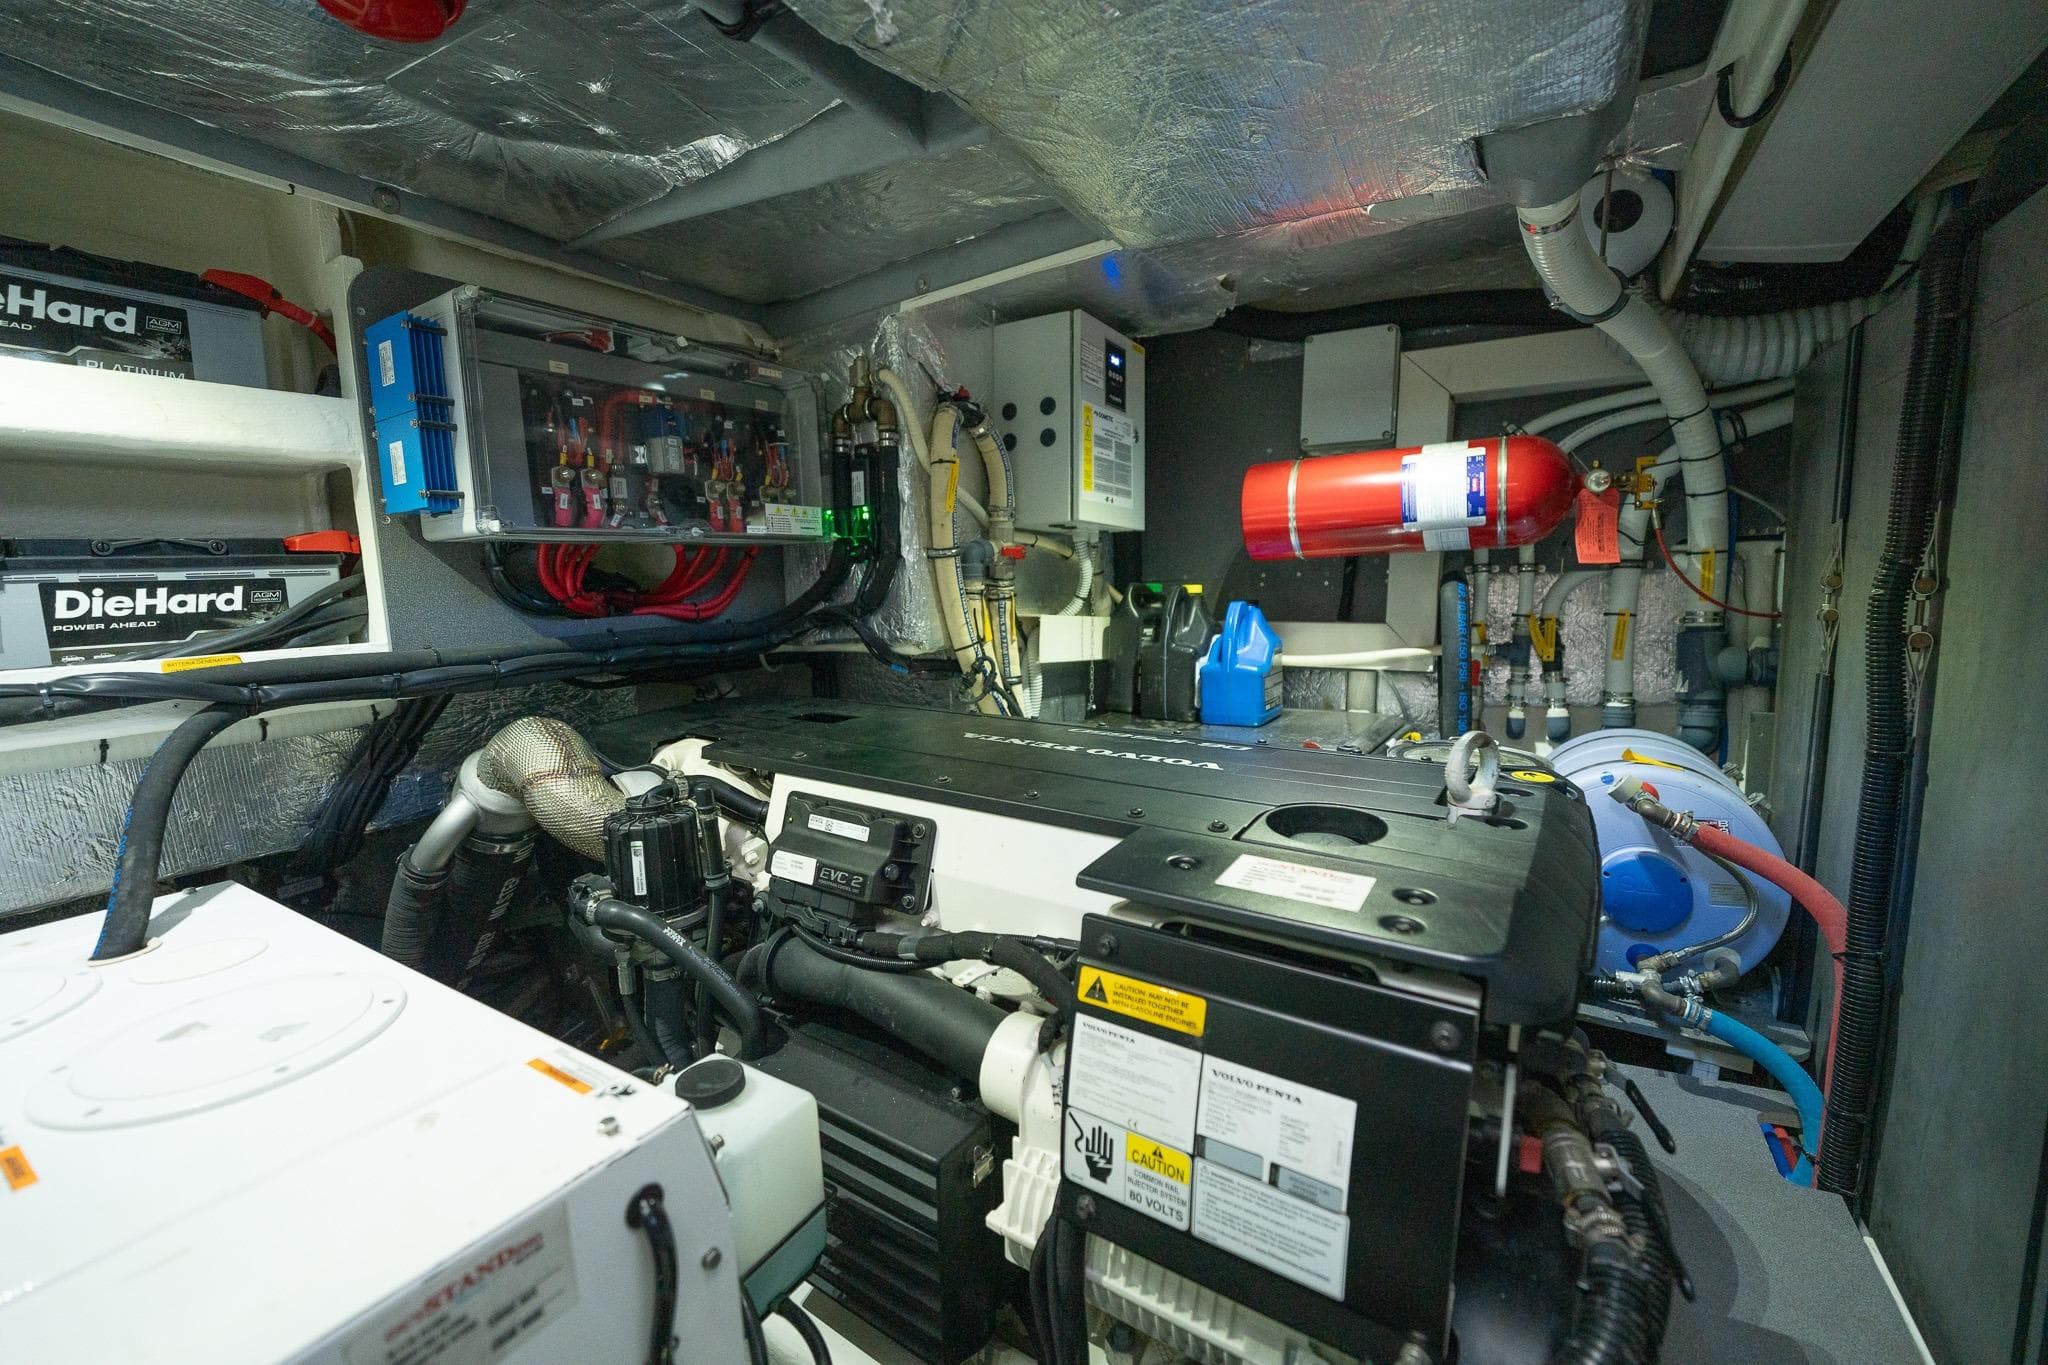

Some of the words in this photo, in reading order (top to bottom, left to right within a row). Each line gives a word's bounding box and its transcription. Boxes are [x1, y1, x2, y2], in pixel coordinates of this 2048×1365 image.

[54, 586, 243, 619] DieHard
[1458, 600, 1467, 610] 10
[52, 623, 105, 632] POWER
[109, 621, 156, 629] AHEAD
[1458, 613, 1468, 634] BAR
[1458, 692, 1468, 710] ISO
[963, 732, 1085, 751] PENTA
[1086, 748, 1224, 770] VOLVO
[820, 867, 848, 884] EVC
[851, 875, 863, 888] 2
[1111, 999, 1130, 1010] WITH
[1130, 1004, 1164, 1019] GASOLINE
[1112, 990, 1147, 1006] INSTALLED
[1147, 1001, 1184, 1016] TOGETHER
[1148, 992, 1164, 1001] MAY
[1181, 1001, 1190, 1009] BE
[1082, 1021, 1108, 1034] VOLVO
[1108, 1030, 1135, 1044] PENTA
[1211, 1068, 1254, 1088] VOLVO
[1256, 1084, 1302, 1104] PENTA
[1131, 1149, 1185, 1181] CAUTION
[1127, 1176, 1159, 1195] INJECTOR
[1160, 1190, 1187, 1208] SYSTEM
[1134, 1169, 1164, 1187] COMMON
[1164, 1182, 1180, 1193] RAIL
[1129, 1189, 1143, 1204] 80
[1145, 1196, 1184, 1222] VOLTS
